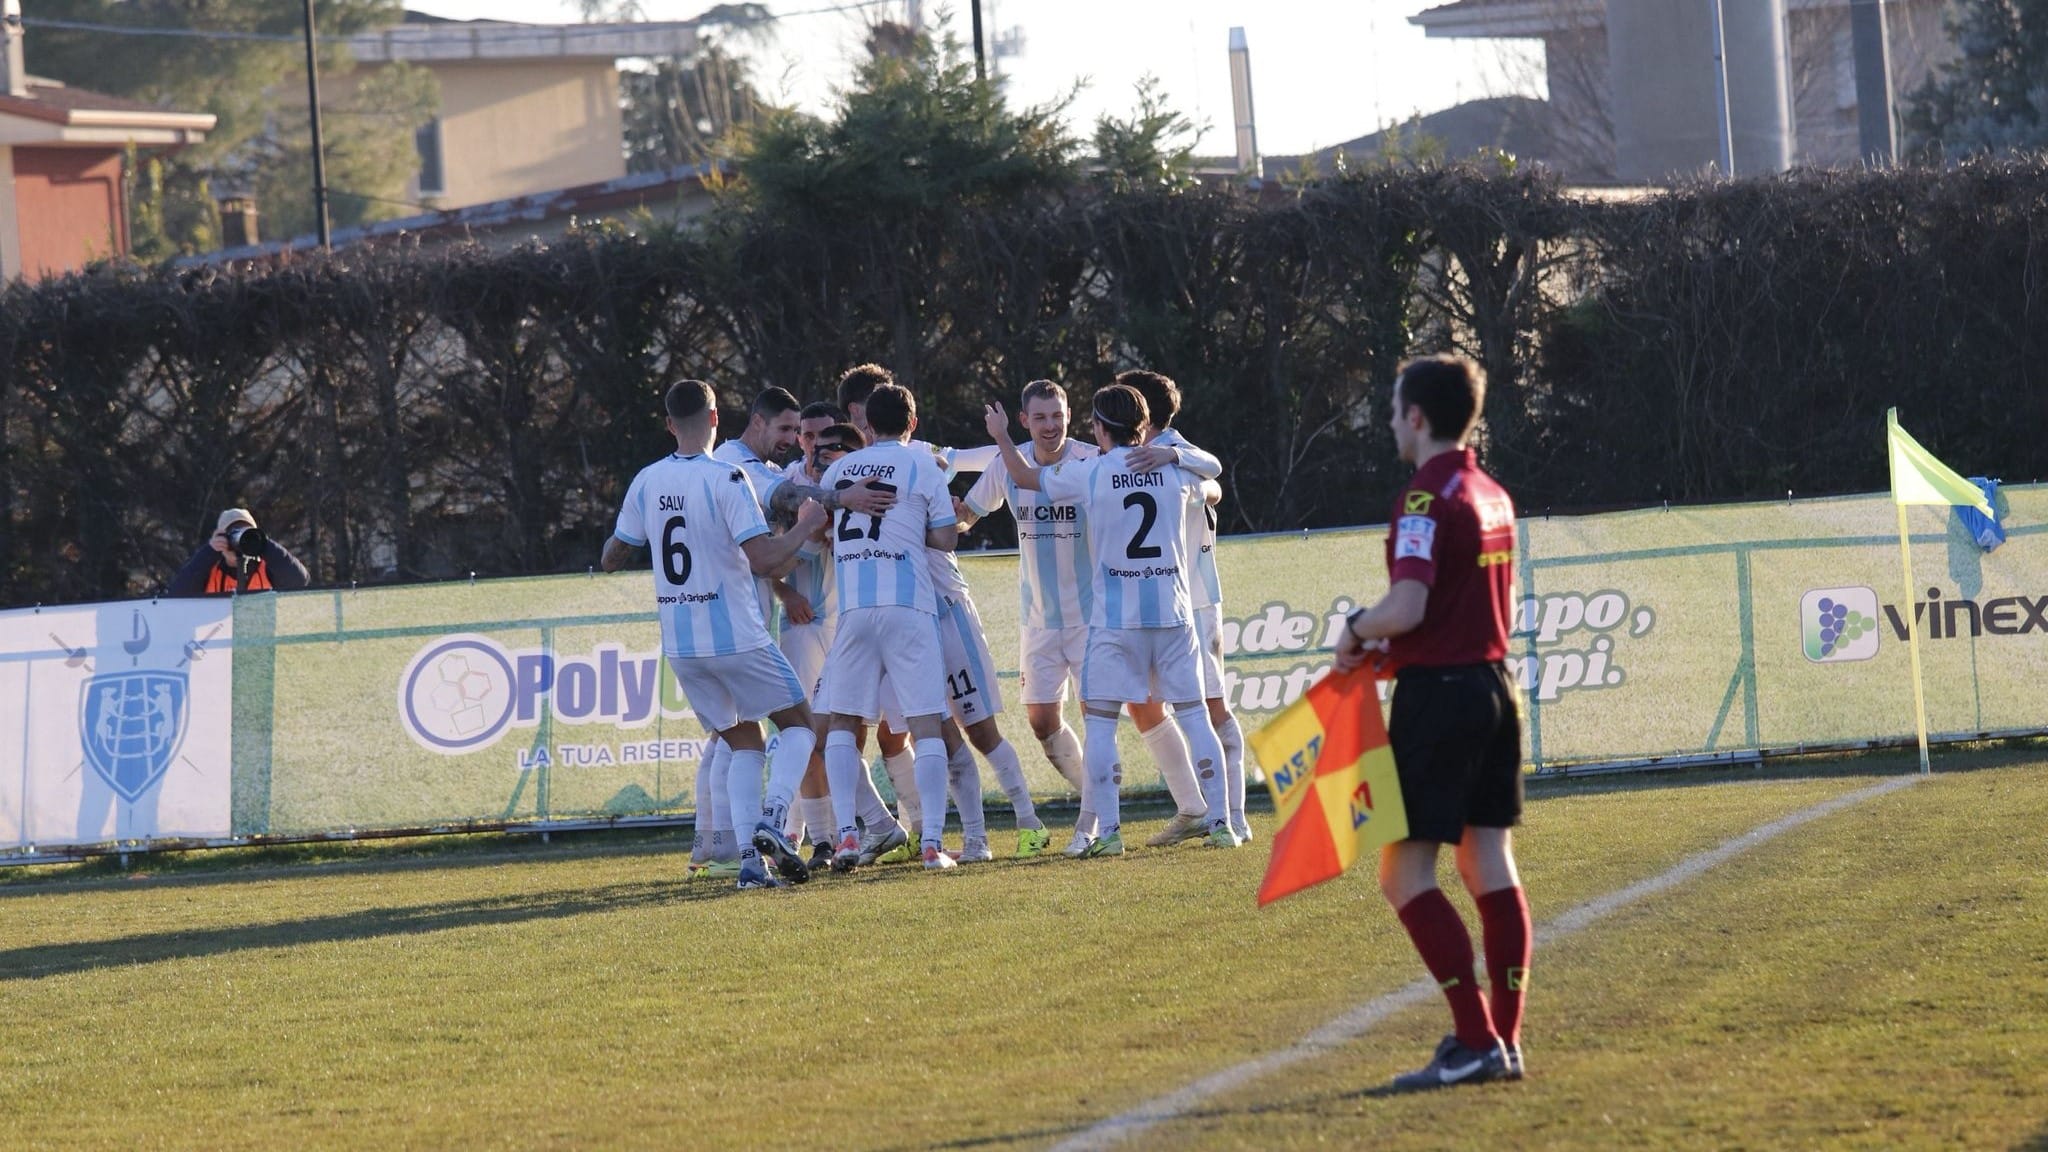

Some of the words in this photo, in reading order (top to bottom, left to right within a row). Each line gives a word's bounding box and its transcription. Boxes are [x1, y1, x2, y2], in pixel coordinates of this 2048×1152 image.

[843, 464, 896, 479] GUCHER
[1112, 472, 1164, 489] BRIGATI
[1034, 506, 1077, 521] CMB
[1123, 491, 1162, 559] 2
[662, 515, 692, 586] 6
[1109, 568, 1141, 579] Gruppo
[947, 669, 977, 701] 11
[521, 749, 550, 767] LA
[560, 748, 612, 765] TUA
